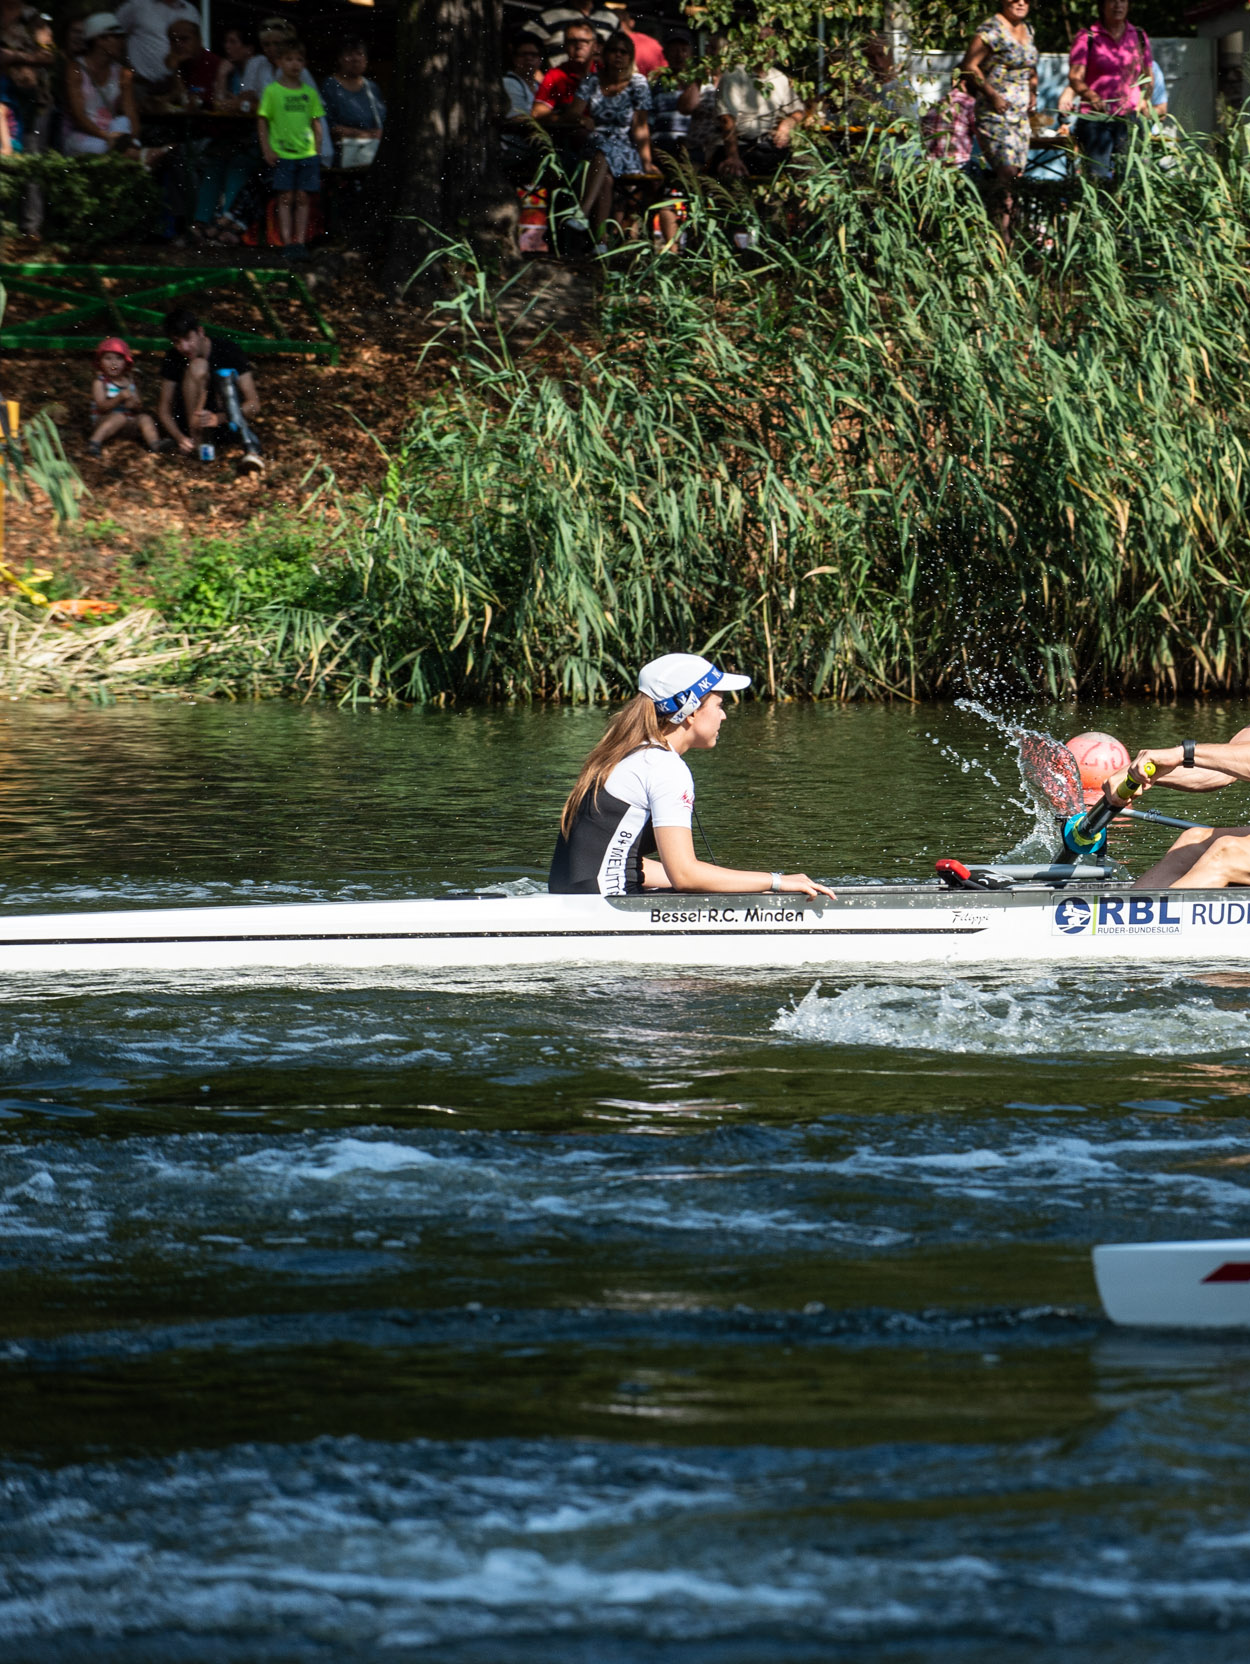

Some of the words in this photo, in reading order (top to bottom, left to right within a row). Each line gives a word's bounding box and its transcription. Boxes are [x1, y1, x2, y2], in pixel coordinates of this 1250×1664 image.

[697, 676, 713, 692] NK
[618, 830, 633, 845] 8+
[650, 908, 738, 923] Bessel-R.C.
[744, 908, 804, 922] Minden
[1098, 896, 1181, 925] RBL
[1097, 926, 1180, 934] RUDER-BUNDESLIGA
